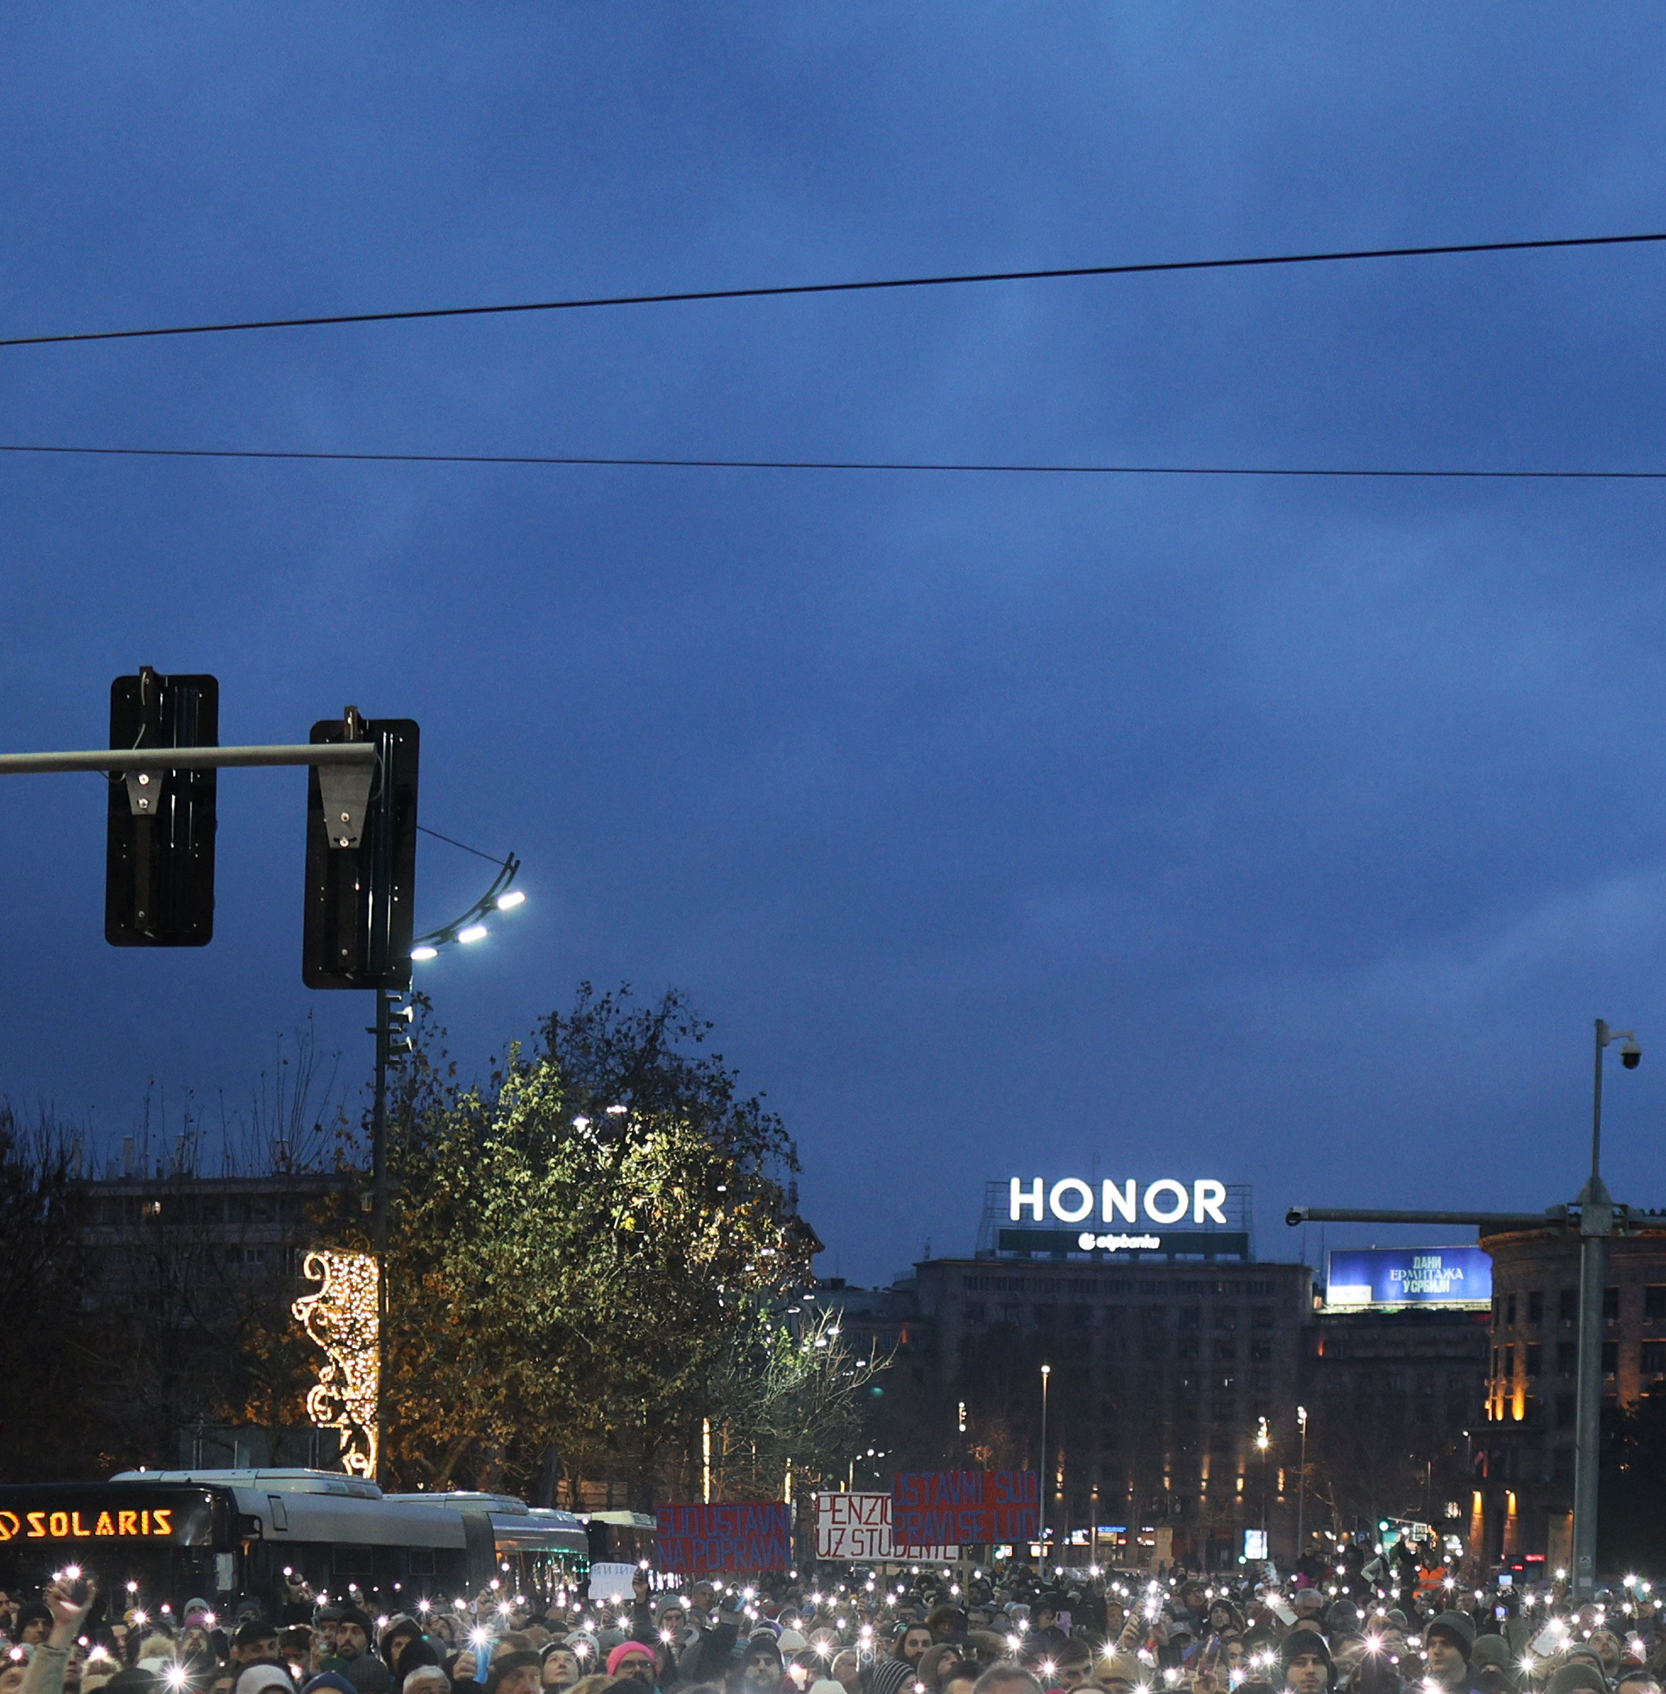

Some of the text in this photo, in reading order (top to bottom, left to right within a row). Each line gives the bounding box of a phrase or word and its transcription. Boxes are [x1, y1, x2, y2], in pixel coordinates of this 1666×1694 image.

[1009, 1177, 1227, 1224] HONOR
[1390, 1268, 1464, 1281] ЕРМИТАЖА
[1413, 1256, 1442, 1269] ДАНИ
[892, 1470, 1040, 1506] USTAVNI SUD
[27, 1509, 172, 1538] SOLARIS
[656, 1506, 700, 1538] SUD
[892, 1508, 1039, 1546] PRAVI SE LUD
[657, 1538, 688, 1572] NA
[816, 1528, 846, 1558] UZ
